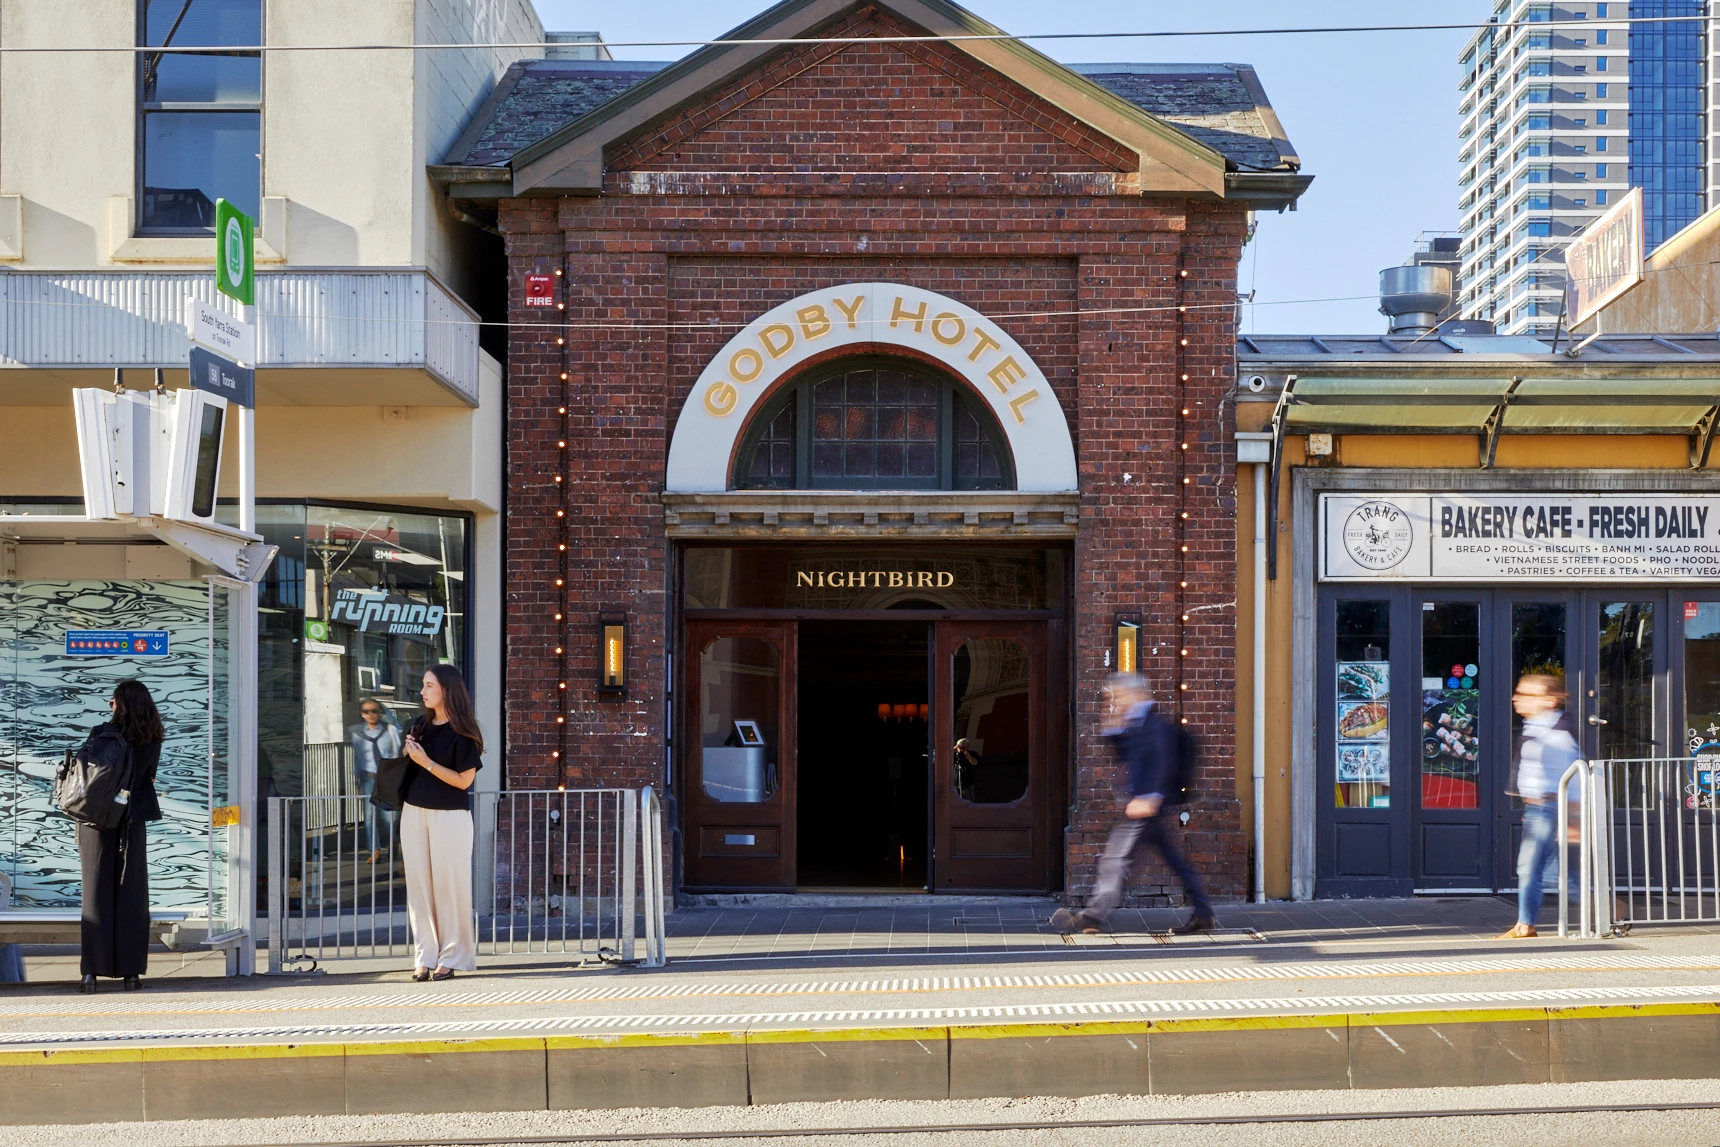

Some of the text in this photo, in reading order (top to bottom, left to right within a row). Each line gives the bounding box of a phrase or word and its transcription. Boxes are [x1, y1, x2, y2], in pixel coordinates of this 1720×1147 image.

[1587, 208, 1632, 303] BAKERY
[526, 296, 552, 306] FIRE
[201, 310, 240, 339] South Yarra Station
[703, 295, 1039, 424] GODBY HOTEL
[211, 369, 237, 389] 58 Toorak
[1356, 506, 1399, 522] TRANG
[1441, 506, 1709, 538] BAKERY CAFE FRESH DAILY
[1354, 546, 1378, 564] BAKERY
[1387, 546, 1402, 560] CAFE
[1494, 556, 1559, 564] VIETNAMESE
[1562, 556, 1600, 564] STREET
[1603, 556, 1639, 564] FOODS
[1650, 556, 1671, 564] PHO
[796, 571, 954, 588] NIGHTBIRD
[336, 589, 358, 600] the
[330, 586, 445, 635] running
[388, 623, 423, 634] ROOM
